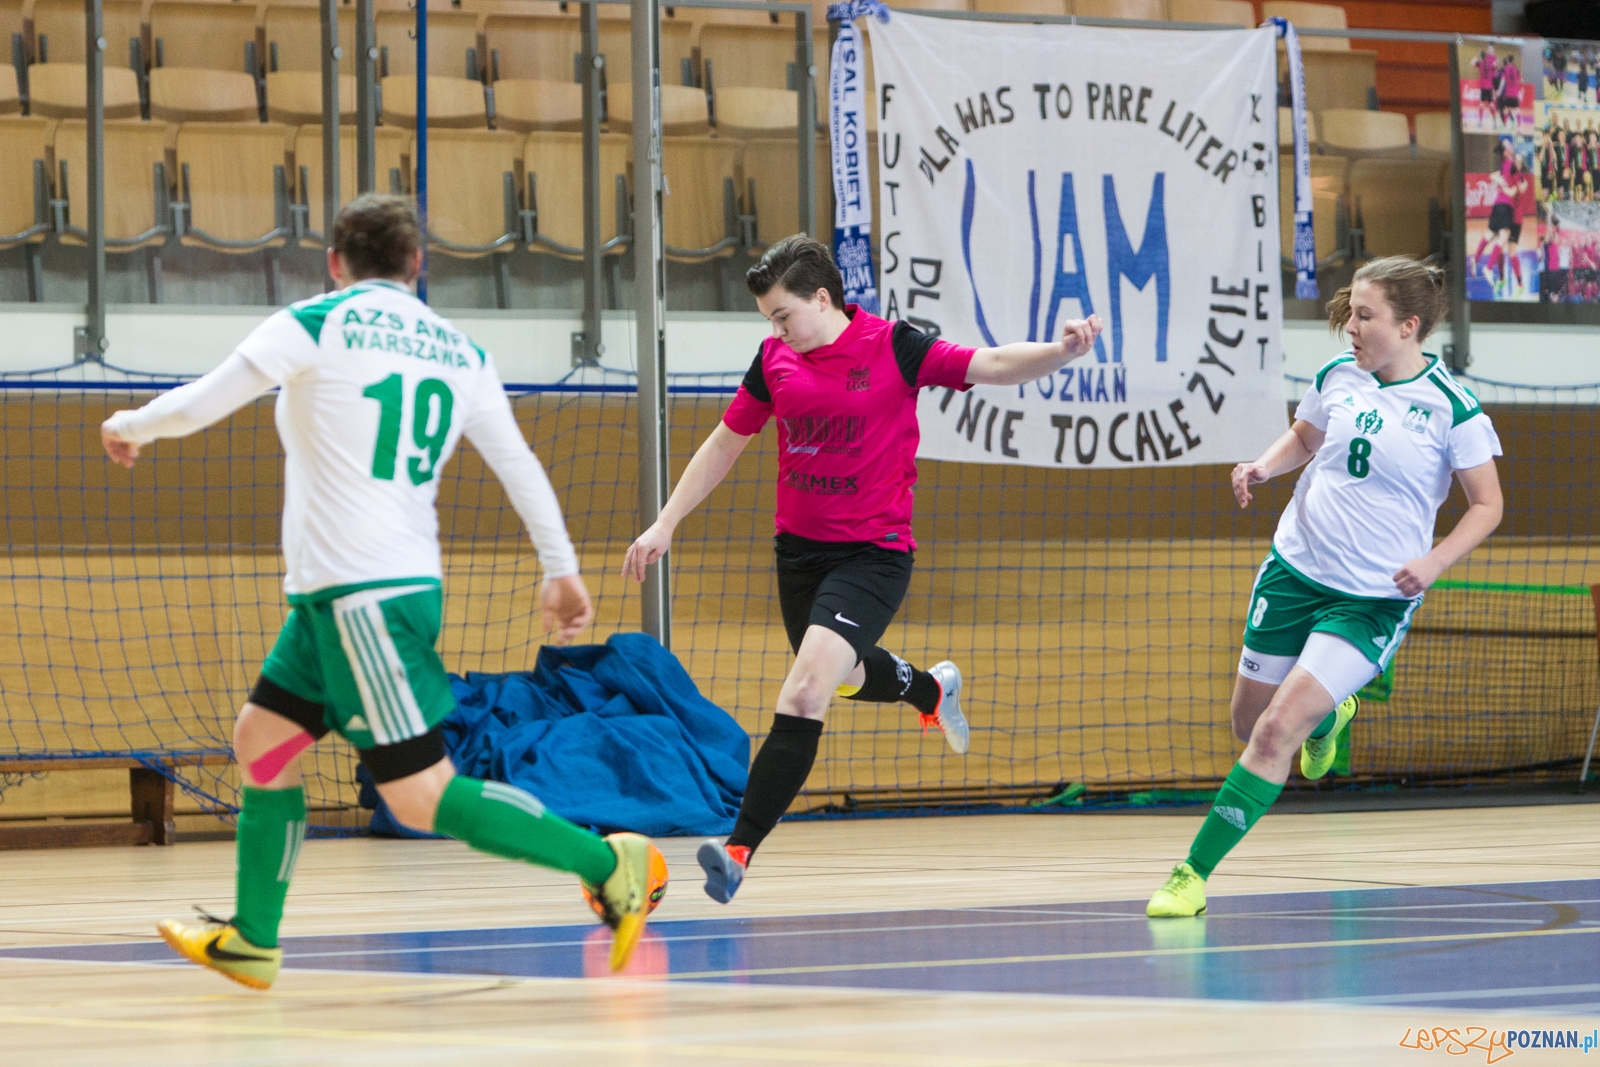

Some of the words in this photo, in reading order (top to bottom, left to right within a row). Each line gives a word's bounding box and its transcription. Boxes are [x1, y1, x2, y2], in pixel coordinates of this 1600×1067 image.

[844, 111, 861, 211] KOBIET
[954, 86, 1015, 134] WAS
[1033, 83, 1073, 120] TO
[1087, 81, 1153, 124] PARE
[1158, 99, 1240, 184] LITER
[881, 83, 901, 321] FUTSA
[960, 157, 1170, 363] UAM
[343, 308, 405, 331] AZS
[416, 319, 462, 347] AWF
[343, 328, 471, 369] WARSZAWA
[1051, 414, 1099, 465] TO
[1179, 275, 1250, 415] ŻYCIE
[362, 371, 454, 486] 19
[1347, 437, 1372, 479] 8
[1251, 596, 1268, 628] 8
